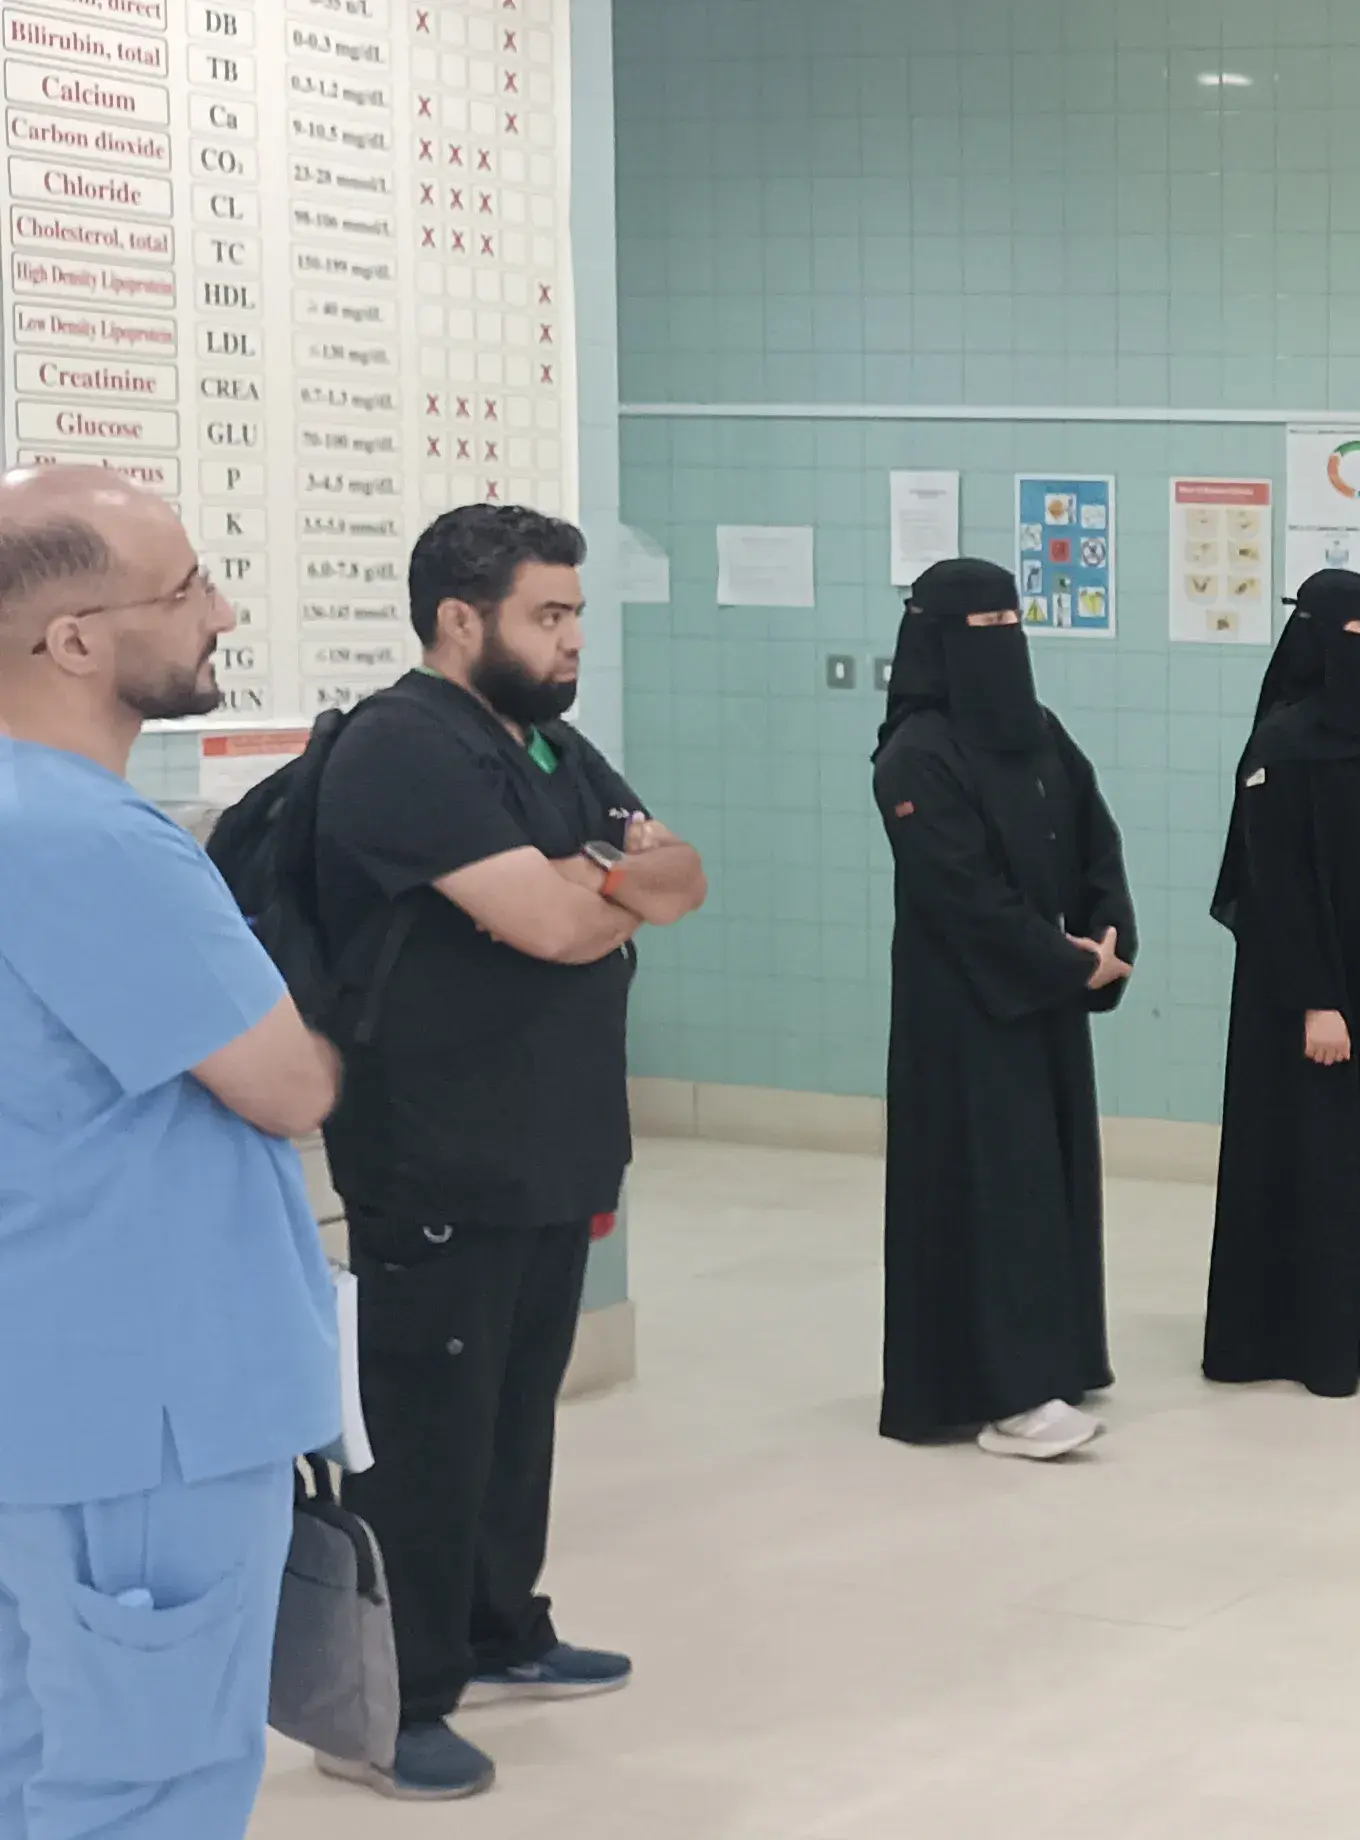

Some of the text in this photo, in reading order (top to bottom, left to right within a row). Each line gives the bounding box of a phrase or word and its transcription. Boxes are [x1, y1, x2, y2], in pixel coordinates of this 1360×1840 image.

[205, 9, 238, 37] DB
[416, 10, 429, 34] X
[11, 20, 161, 68] Bilirubin, total
[503, 29, 517, 53] X
[206, 57, 239, 83] TB
[503, 70, 518, 93] X
[41, 74, 136, 112] Calcium
[418, 94, 431, 118] X
[209, 104, 238, 130] Ca
[505, 112, 518, 135] X
[11, 116, 166, 160] Carbon dioxide
[419, 138, 491, 171] X X X
[44, 170, 142, 207] Chloride
[420, 182, 492, 215] X X X
[211, 195, 244, 220] CL
[16, 215, 168, 253] Cholesterol, total
[421, 225, 494, 257] X X X
[211, 240, 245, 265] TC
[16, 261, 47, 287] High
[51, 266, 97, 293] Density
[204, 282, 255, 309] HDL
[538, 282, 551, 304] X
[18, 312, 46, 332] Low
[50, 315, 97, 342] Density
[539, 322, 552, 344] X
[206, 330, 255, 357] LDL
[39, 362, 156, 395] Creatinine
[540, 363, 553, 384] X
[201, 377, 260, 401] CREA
[426, 392, 498, 421] X X X
[56, 412, 143, 440] Glucose
[207, 422, 258, 448] GLU
[427, 436, 498, 461] X X X
[227, 468, 241, 490] P
[486, 480, 499, 500] X
[226, 512, 243, 536] K
[221, 558, 251, 580] TP
[222, 648, 254, 670] TG
